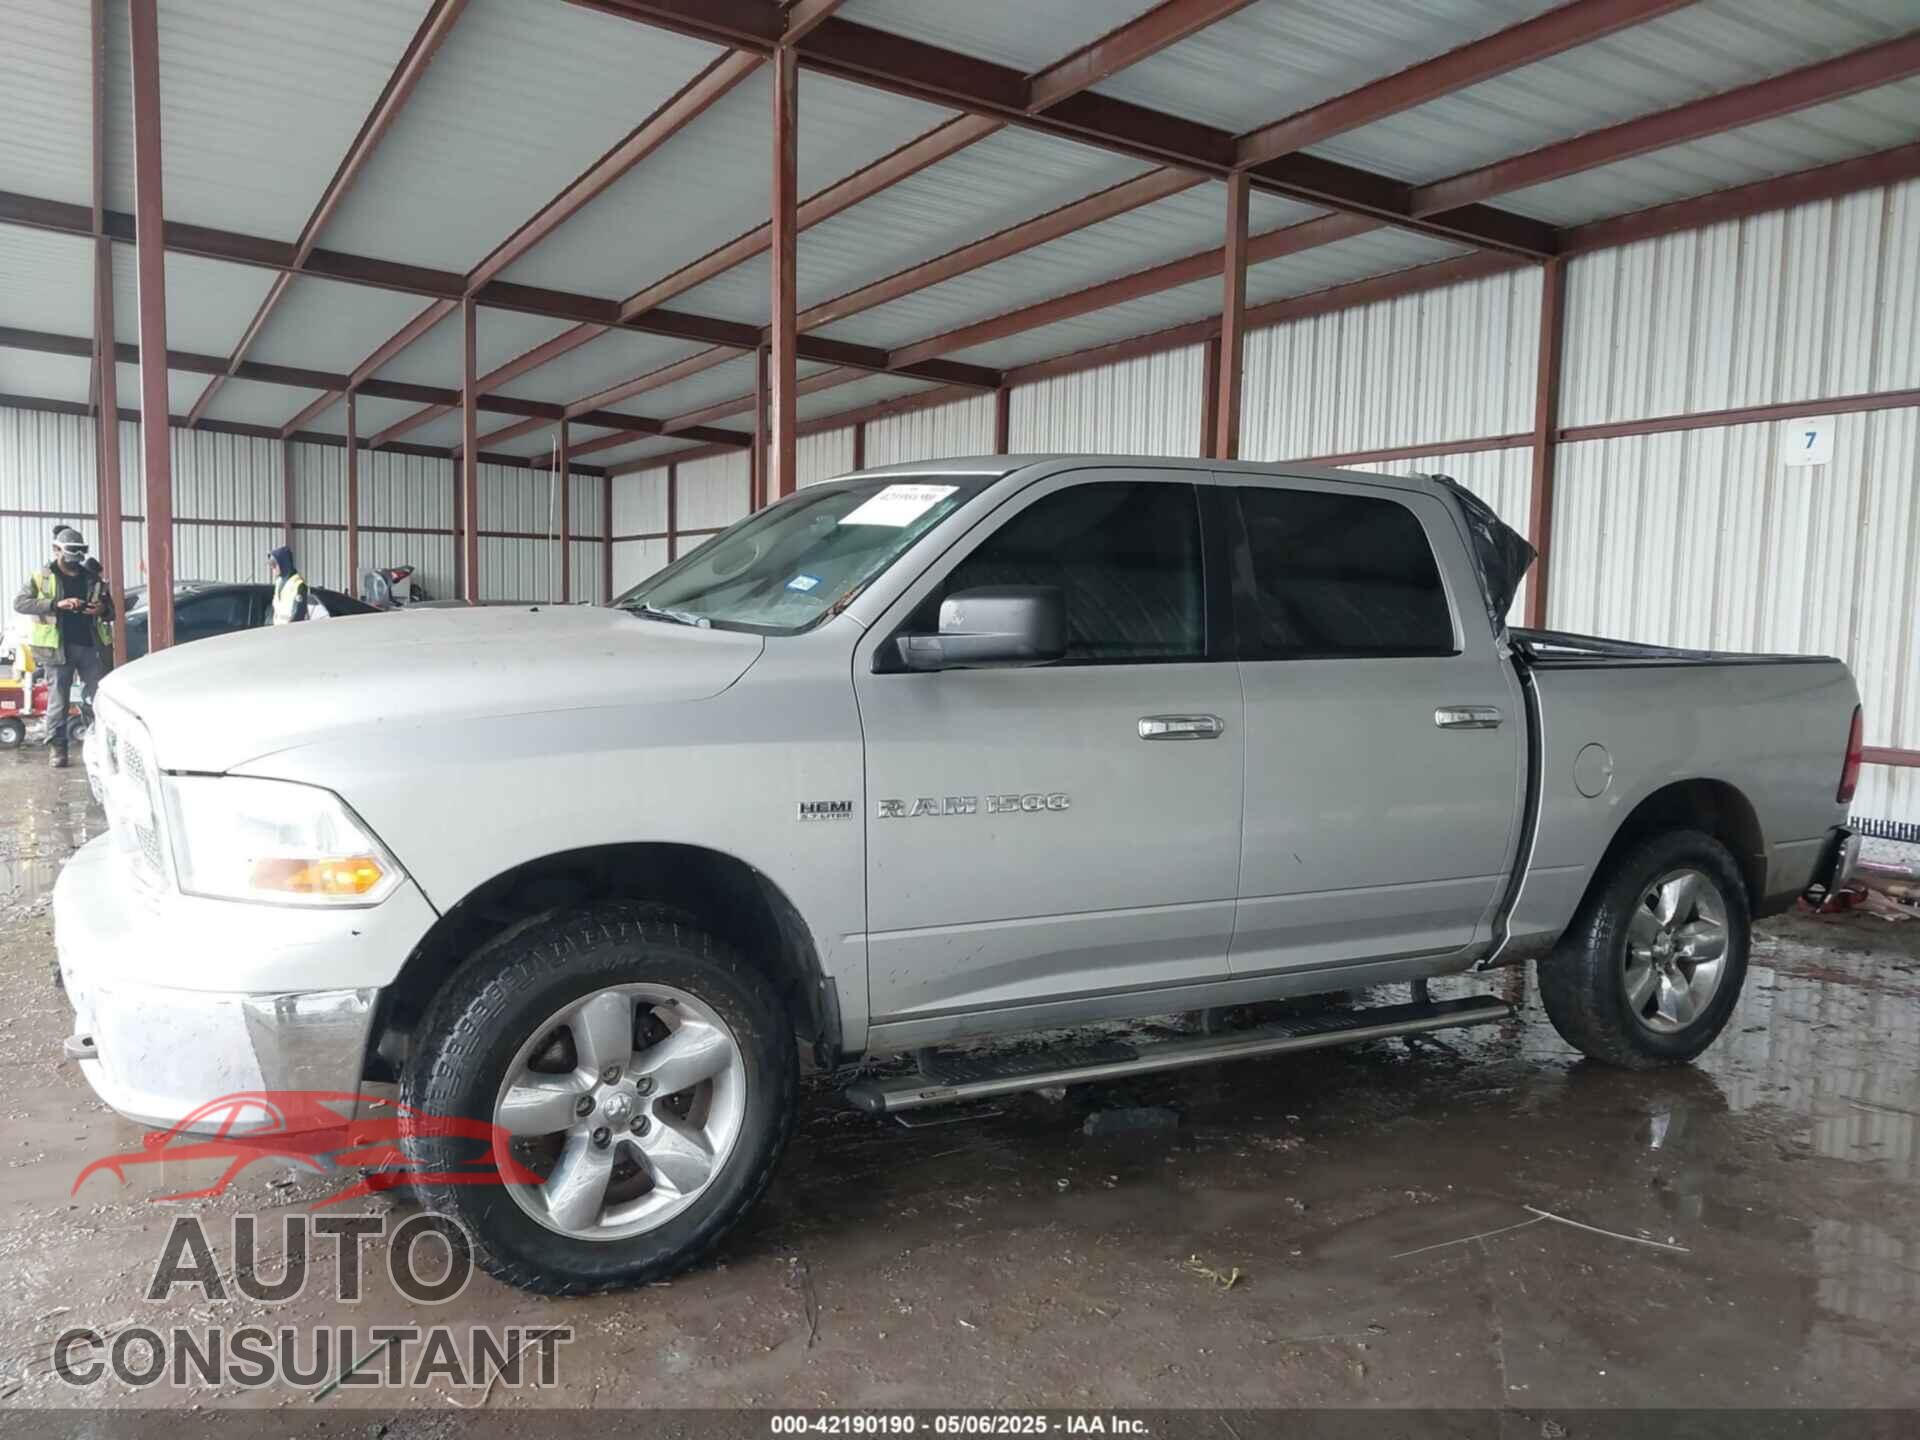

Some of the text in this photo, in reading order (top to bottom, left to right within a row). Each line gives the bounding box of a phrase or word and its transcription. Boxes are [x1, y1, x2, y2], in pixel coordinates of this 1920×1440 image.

[1804, 431, 1817, 449] 7
[800, 801, 852, 813] HEMI
[876, 793, 1071, 818] RAM 1500
